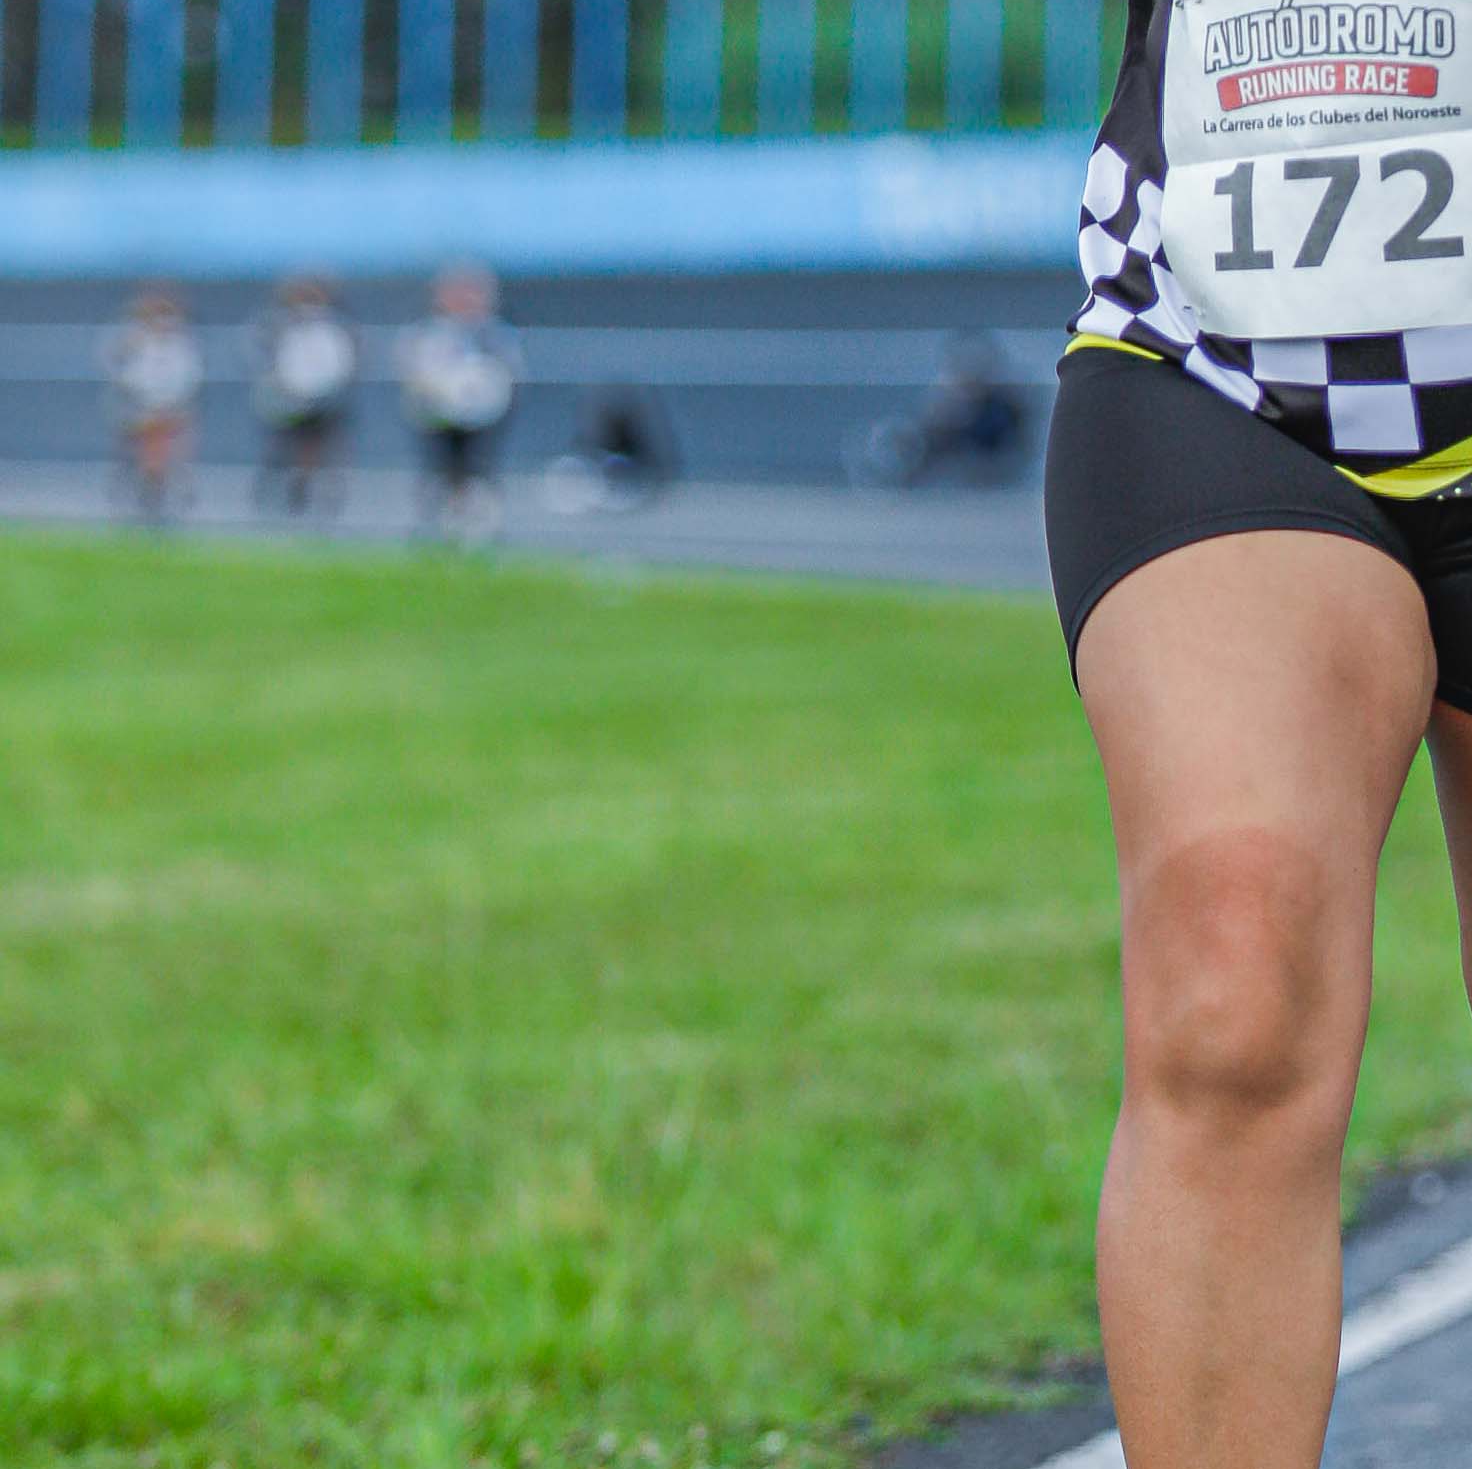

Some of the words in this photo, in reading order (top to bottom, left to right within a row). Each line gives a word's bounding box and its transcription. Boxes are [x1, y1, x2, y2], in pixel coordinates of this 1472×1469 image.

[1238, 65, 1336, 106] RUNNING
[1344, 62, 1410, 95] RACE
[1203, 119, 1217, 133] La
[1219, 118, 1264, 132] Carrera
[1267, 114, 1283, 129] de
[1286, 112, 1305, 127] los
[1309, 109, 1361, 125] Clubes
[1365, 106, 1389, 122] del
[1393, 104, 1462, 121] Noroeste
[1213, 147, 1465, 272] 172
